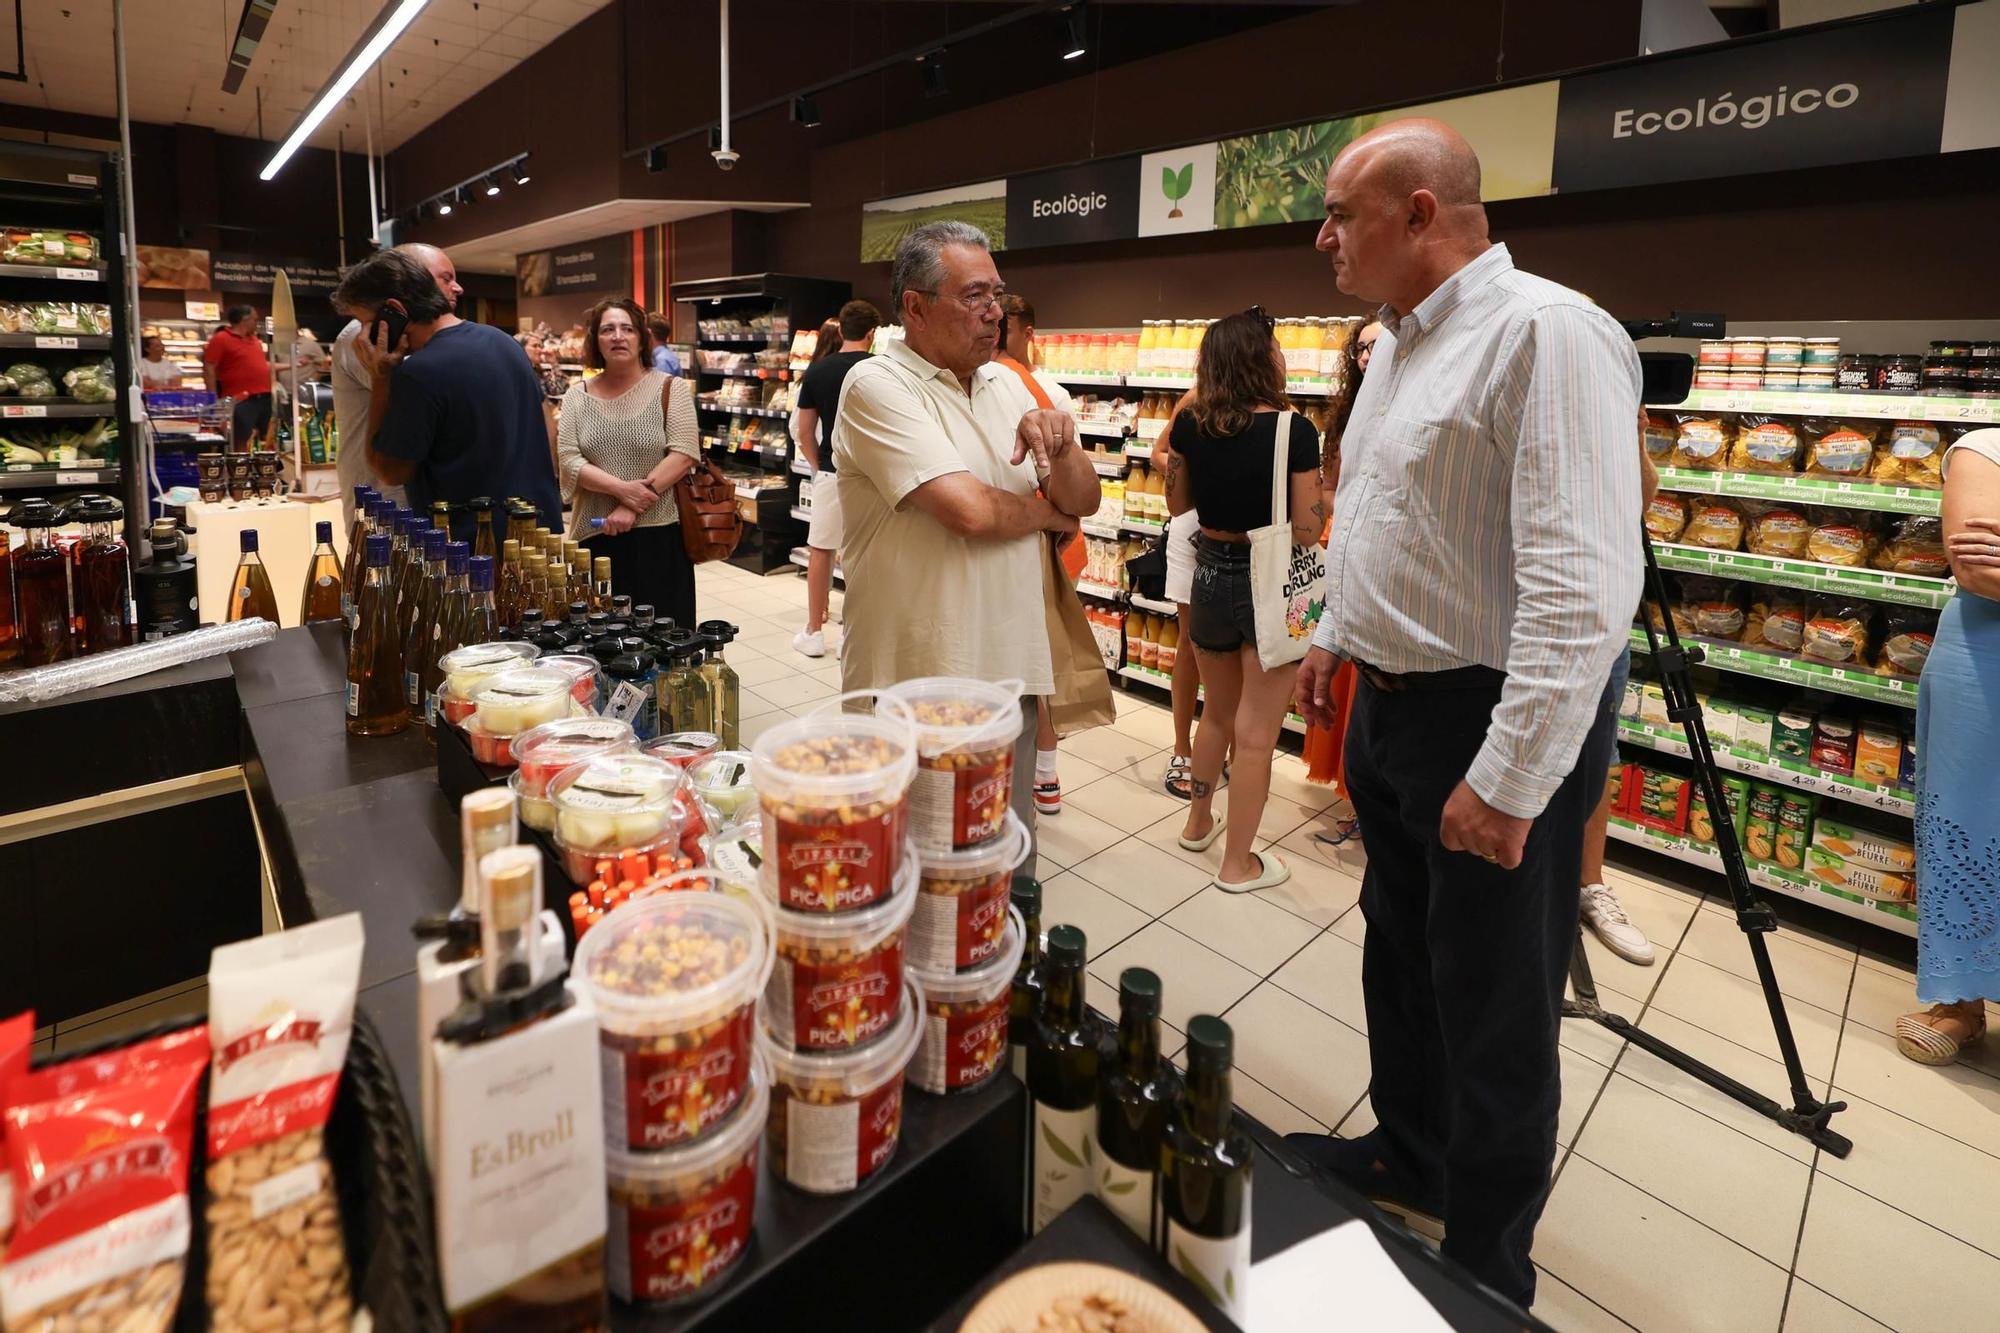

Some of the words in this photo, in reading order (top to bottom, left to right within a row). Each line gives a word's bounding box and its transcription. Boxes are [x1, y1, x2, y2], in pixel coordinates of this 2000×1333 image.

[1612, 82, 1861, 139] Ecológico
[1032, 191, 1107, 218] Ecològic
[214, 261, 253, 271] Acabat
[214, 271, 250, 282] Recién
[251, 274, 277, 284] hech
[1726, 485, 1766, 494] ecológico
[1778, 489, 1820, 498] ecológico
[1832, 496, 1876, 506] ecológico
[1890, 503, 1938, 512] ecológico
[1823, 584, 1866, 595] ecológico
[1881, 592, 1927, 604] ecológico
[1816, 680, 1860, 694] ecológico
[1792, 775, 1816, 786] 4.29
[1827, 784, 1852, 796] 4.29
[1875, 796, 1901, 808] 4.29
[1863, 841, 1886, 855] PETIT
[1856, 848, 1889, 866] BEURRE
[1853, 870, 1877, 884] PETIT
[1781, 880, 1805, 893] 2.85
[789, 886, 826, 906] PICA
[835, 883, 873, 905] PICA
[969, 939, 997, 961] PICA
[809, 1028, 847, 1044] PICA
[855, 1011, 889, 1039] PICA
[960, 1060, 990, 1082] PICA
[644, 1119, 689, 1143] PICA
[699, 1088, 737, 1127] PICA
[470, 1108, 575, 1180] EsBroll
[647, 1270, 694, 1293] PICA
